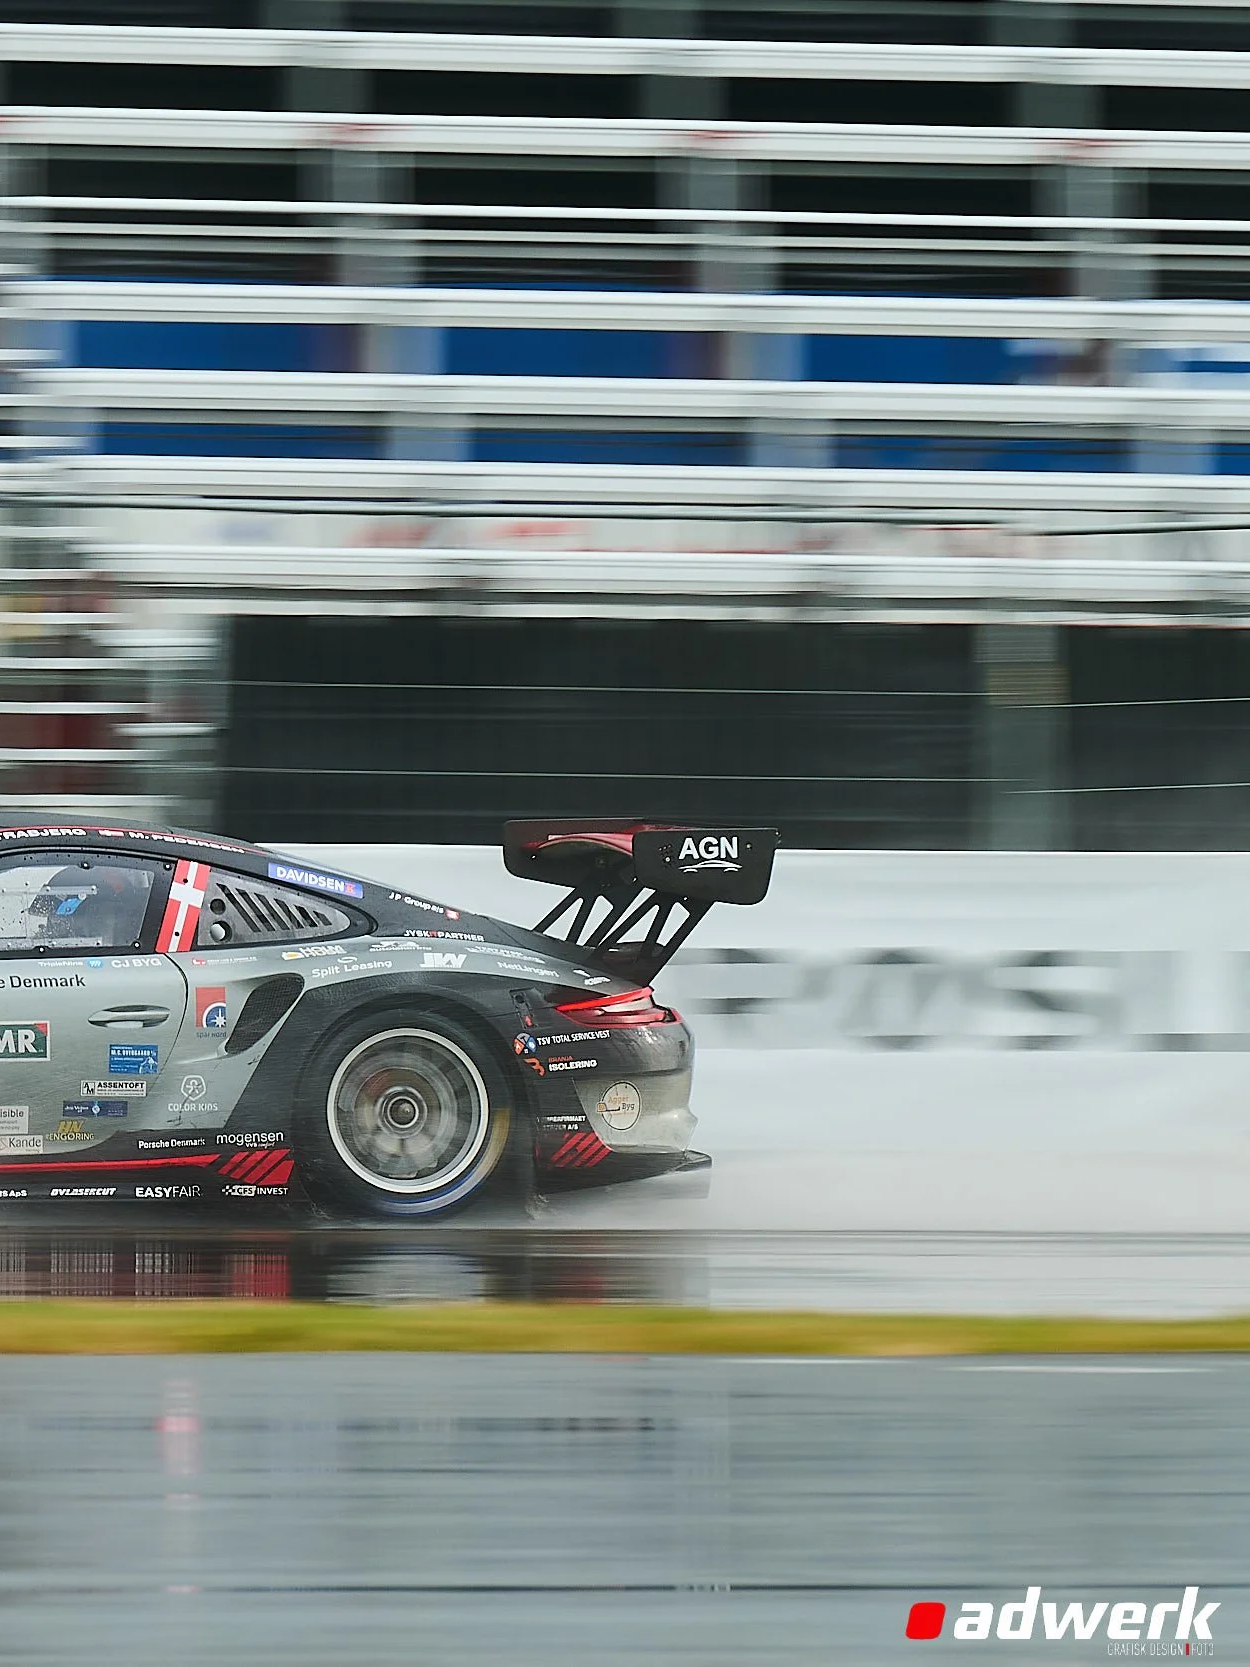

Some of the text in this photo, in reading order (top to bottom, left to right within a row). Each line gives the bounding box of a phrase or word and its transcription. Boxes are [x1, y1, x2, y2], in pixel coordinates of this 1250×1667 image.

[678, 836, 739, 860] AGN
[276, 866, 345, 893] DAVIDSEN
[404, 896, 431, 910] Group
[111, 959, 130, 968] CJ
[132, 958, 162, 967] BYG
[311, 959, 393, 979] Split Leasing
[9, 974, 86, 988] Denmark
[537, 1037, 551, 1046] TSV
[551, 1034, 571, 1044] TOTAL
[549, 1060, 598, 1072] ISOLERING
[167, 1103, 218, 1112] COLOR KIDS
[622, 1103, 635, 1111] Byg
[138, 1138, 205, 1149] Porsche Denmark
[216, 1131, 284, 1147] mogensen
[135, 1185, 201, 1199] EASYFAIR
[257, 1187, 289, 1196] INVEST
